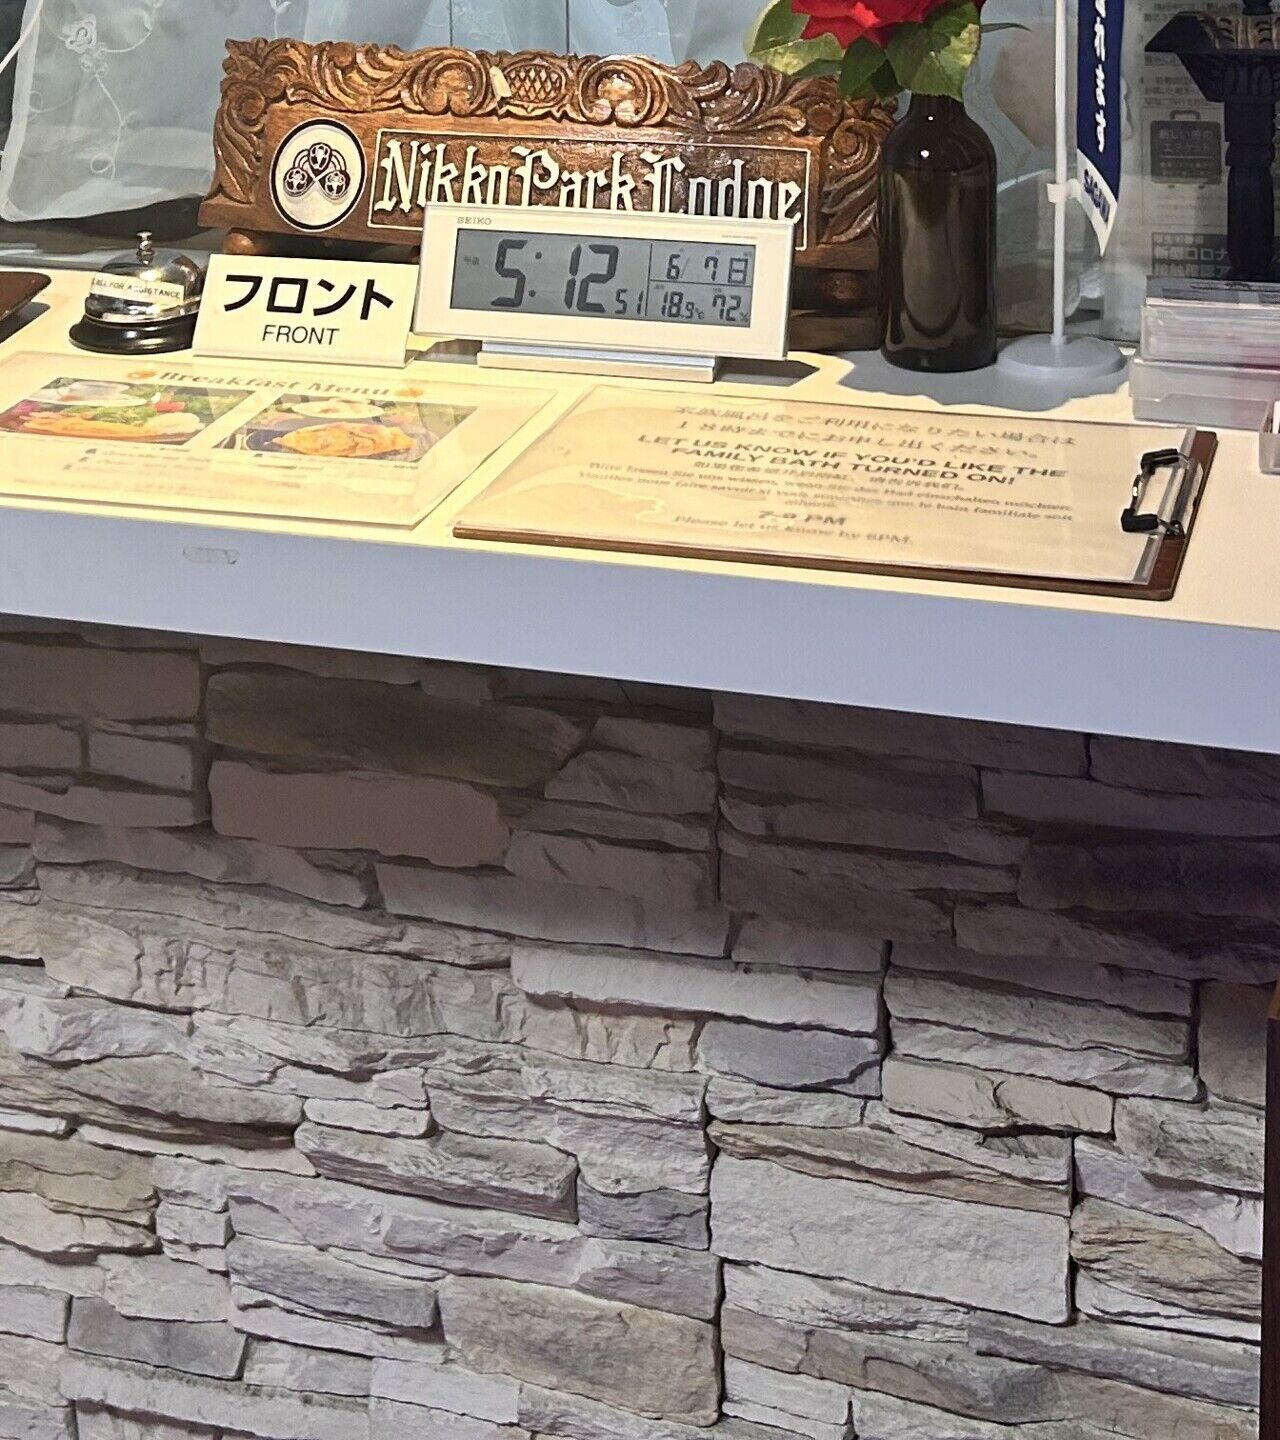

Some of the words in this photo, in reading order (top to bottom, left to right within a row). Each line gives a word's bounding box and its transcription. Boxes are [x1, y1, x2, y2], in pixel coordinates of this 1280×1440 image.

[374, 138, 512, 212] Nikko
[510, 145, 636, 210] Park
[456, 216, 492, 226] SEIKO
[490, 239, 620, 314] 5:12
[614, 288, 645, 316] 51
[728, 257, 749, 285] 日
[109, 281, 125, 291] FOR
[223, 273, 394, 321] フロント
[261, 324, 340, 346] FRONT
[158, 371, 302, 390] Breakfast
[306, 380, 391, 397] Menu
[637, 434, 688, 447] LET
[692, 438, 728, 449] US
[734, 442, 819, 458] KNOW
[822, 450, 849, 459] IF
[855, 453, 937, 467] YOU'D
[943, 459, 1004, 473] LIKE
[1013, 466, 1069, 478] THE
[670, 447, 764, 462] FAMILY
[769, 456, 840, 470] BATH
[850, 463, 959, 480] TURNED
[965, 472, 1016, 485] ON!
[673, 515, 728, 528] Please
[803, 512, 847, 526] PM
